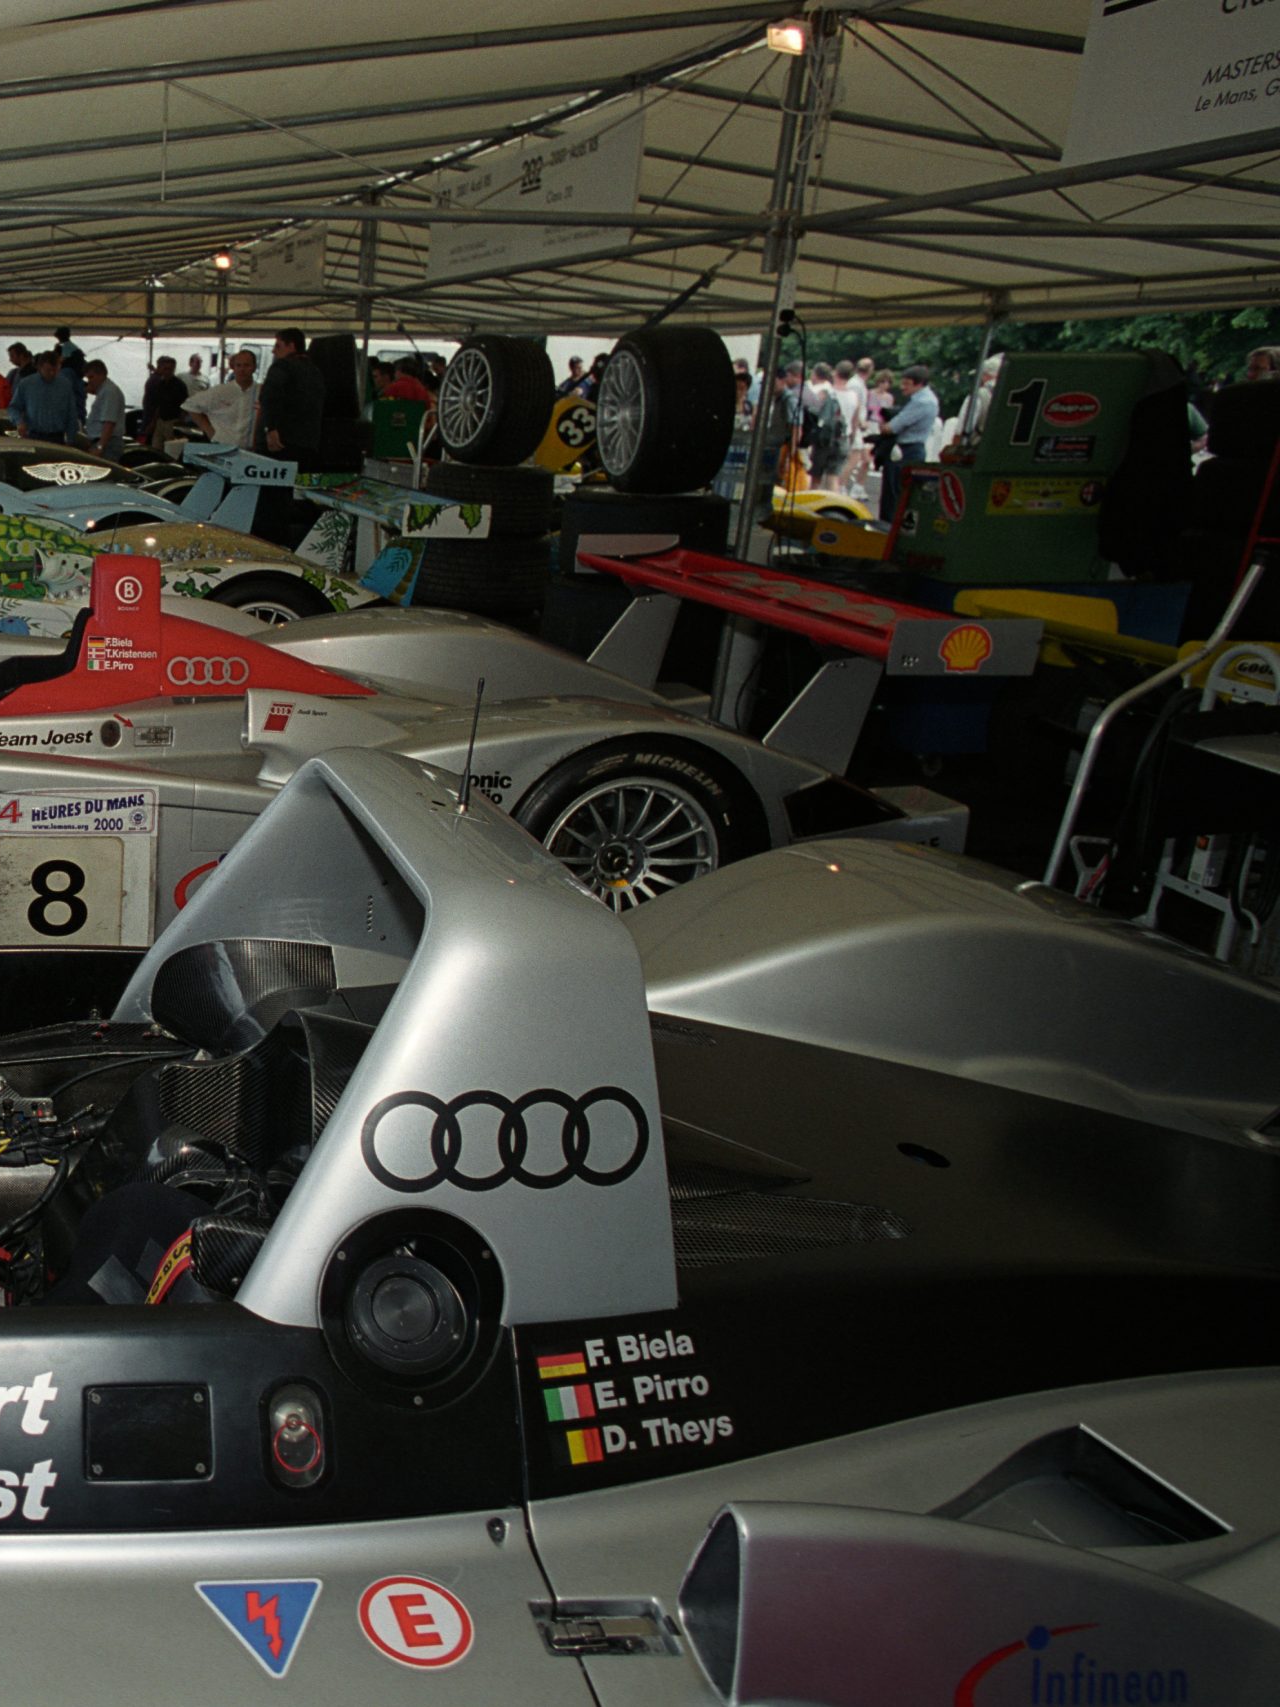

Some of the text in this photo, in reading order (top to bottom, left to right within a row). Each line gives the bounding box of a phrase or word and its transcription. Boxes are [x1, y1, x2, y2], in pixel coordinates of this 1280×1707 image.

[1195, 96, 1211, 112] Le
[1213, 89, 1258, 108] Mans,
[558, 406, 596, 446] 33
[1007, 378, 1048, 445] 1
[244, 465, 288, 479] Gulf
[105, 637, 133, 648] F.Biela
[105, 648, 157, 659] T.Kristensen
[105, 661, 134, 671] E.Pirro
[41, 729, 94, 746] Joest
[634, 753, 723, 796] MICHELIN
[31, 801, 81, 822] HEURES
[84, 799, 103, 815] DU
[107, 793, 145, 812] MANS
[94, 817, 123, 831] 2000
[27, 859, 88, 936] 8
[584, 1330, 695, 1367] F. Biela
[593, 1374, 710, 1410] E. Pirro
[602, 1415, 734, 1454] D. Theys
[387, 1593, 444, 1647] E
[1030, 1651, 1189, 1705] Infineon
